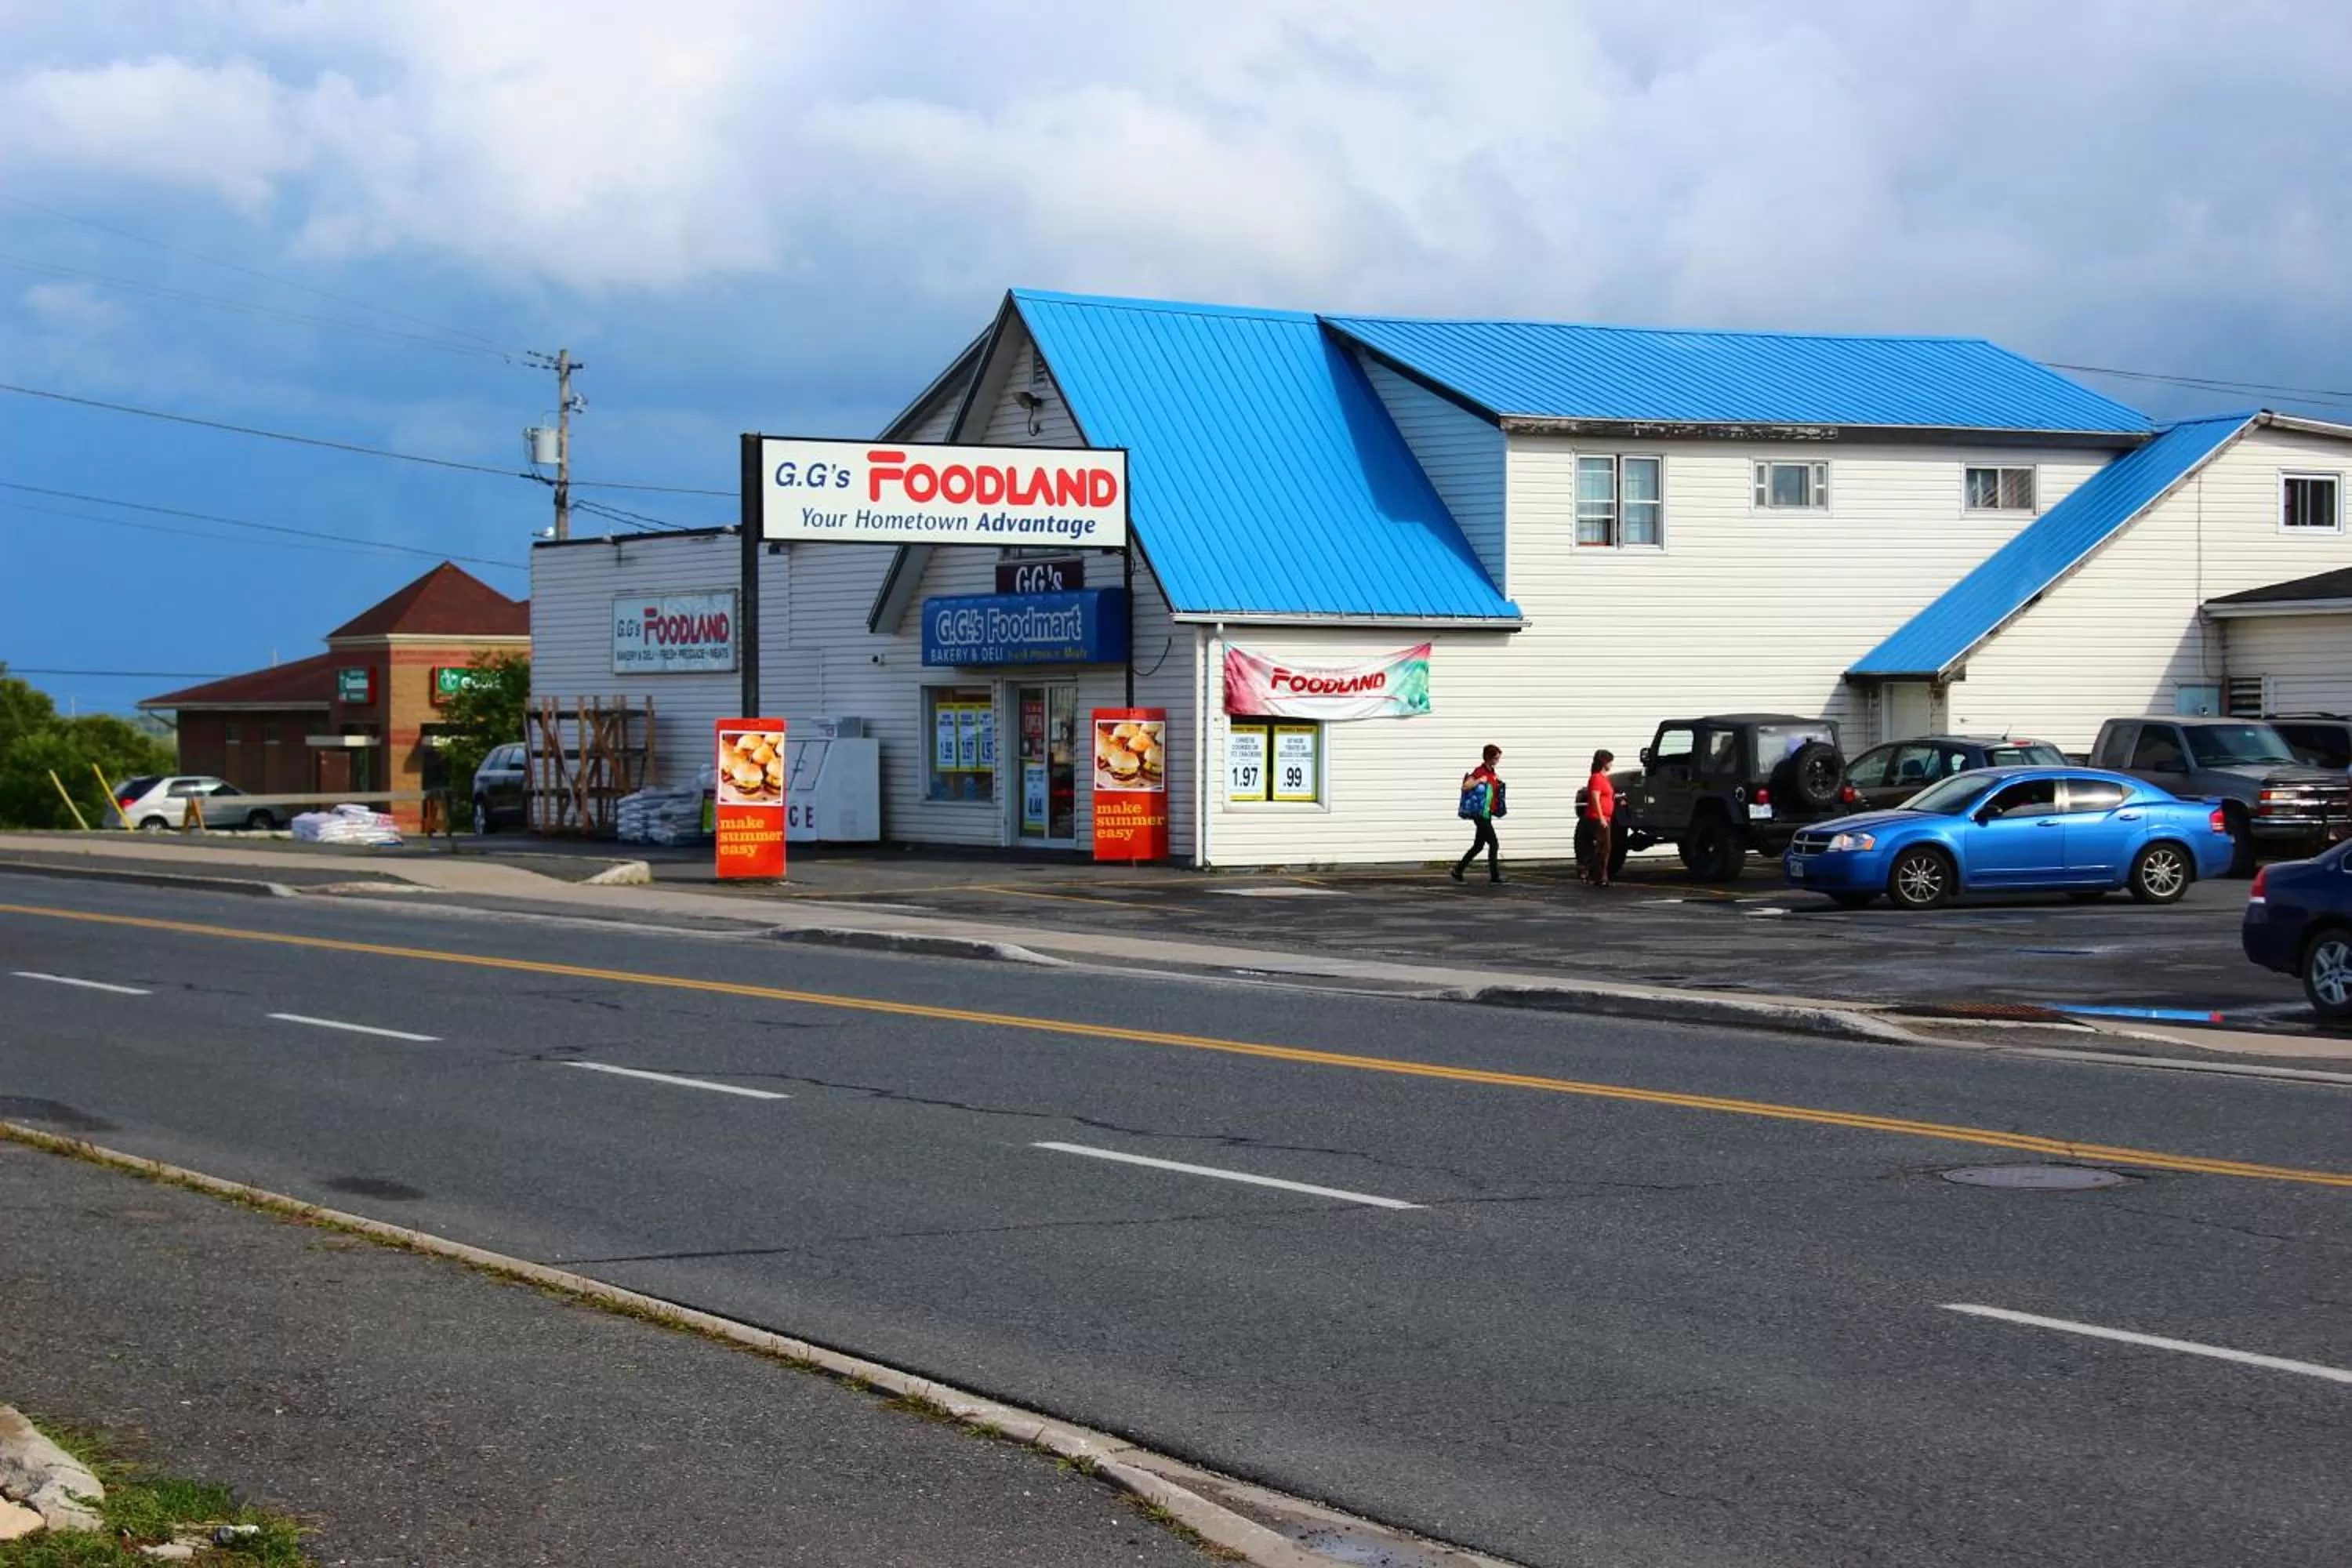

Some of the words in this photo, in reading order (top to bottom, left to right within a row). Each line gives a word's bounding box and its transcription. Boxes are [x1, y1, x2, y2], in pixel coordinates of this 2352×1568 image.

[775, 462, 851, 488] G.G's
[866, 450, 1118, 508] FOODLAND
[801, 507, 848, 528] Your
[855, 509, 969, 532] Hometown
[975, 512, 1096, 539] Advantage
[643, 606, 730, 645] FOODLAND
[987, 604, 1082, 644] Foodmart
[930, 647, 969, 662] BAKERY
[982, 647, 1004, 662] DELI
[1270, 666, 1387, 694] FOODLAND
[1232, 766, 1258, 787] 1.97
[1283, 767, 1302, 787] .99
[789, 805, 815, 829] CE
[1096, 800, 1142, 815] make
[720, 815, 765, 829] make
[1096, 815, 1165, 826] summer
[720, 831, 783, 842] summer
[1096, 828, 1135, 840] easy
[720, 844, 759, 858] easy
